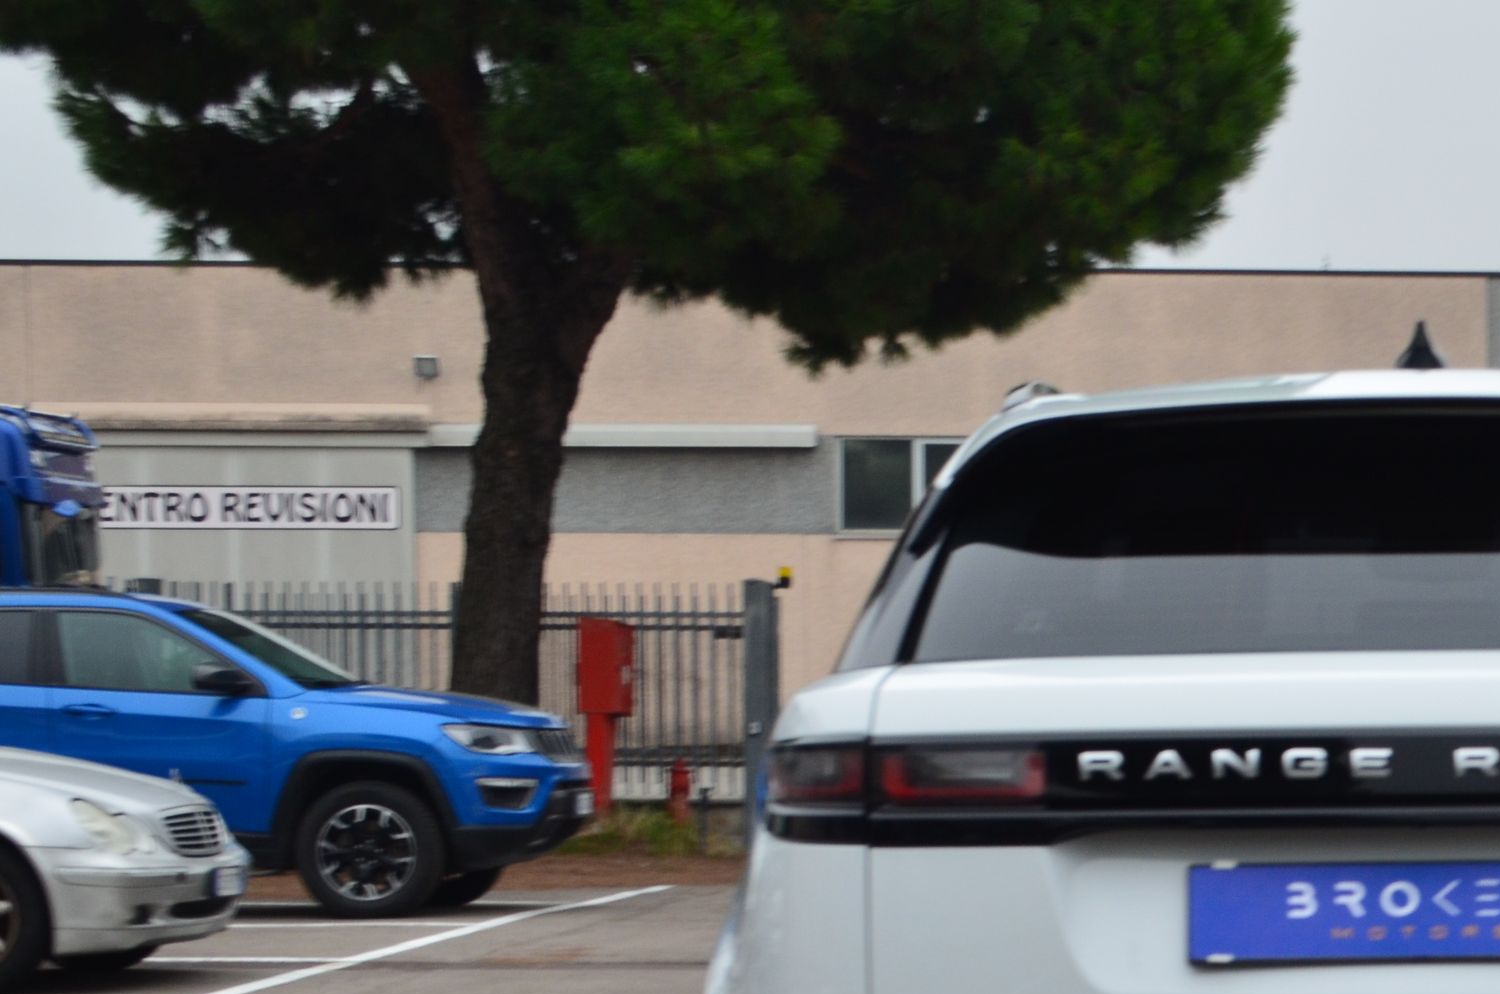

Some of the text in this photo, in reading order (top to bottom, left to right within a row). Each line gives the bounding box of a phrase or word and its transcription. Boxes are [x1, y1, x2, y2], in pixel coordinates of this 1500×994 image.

[100, 492, 389, 522] ENTRO REVISIONI
[1077, 747, 1394, 781] RANGE
